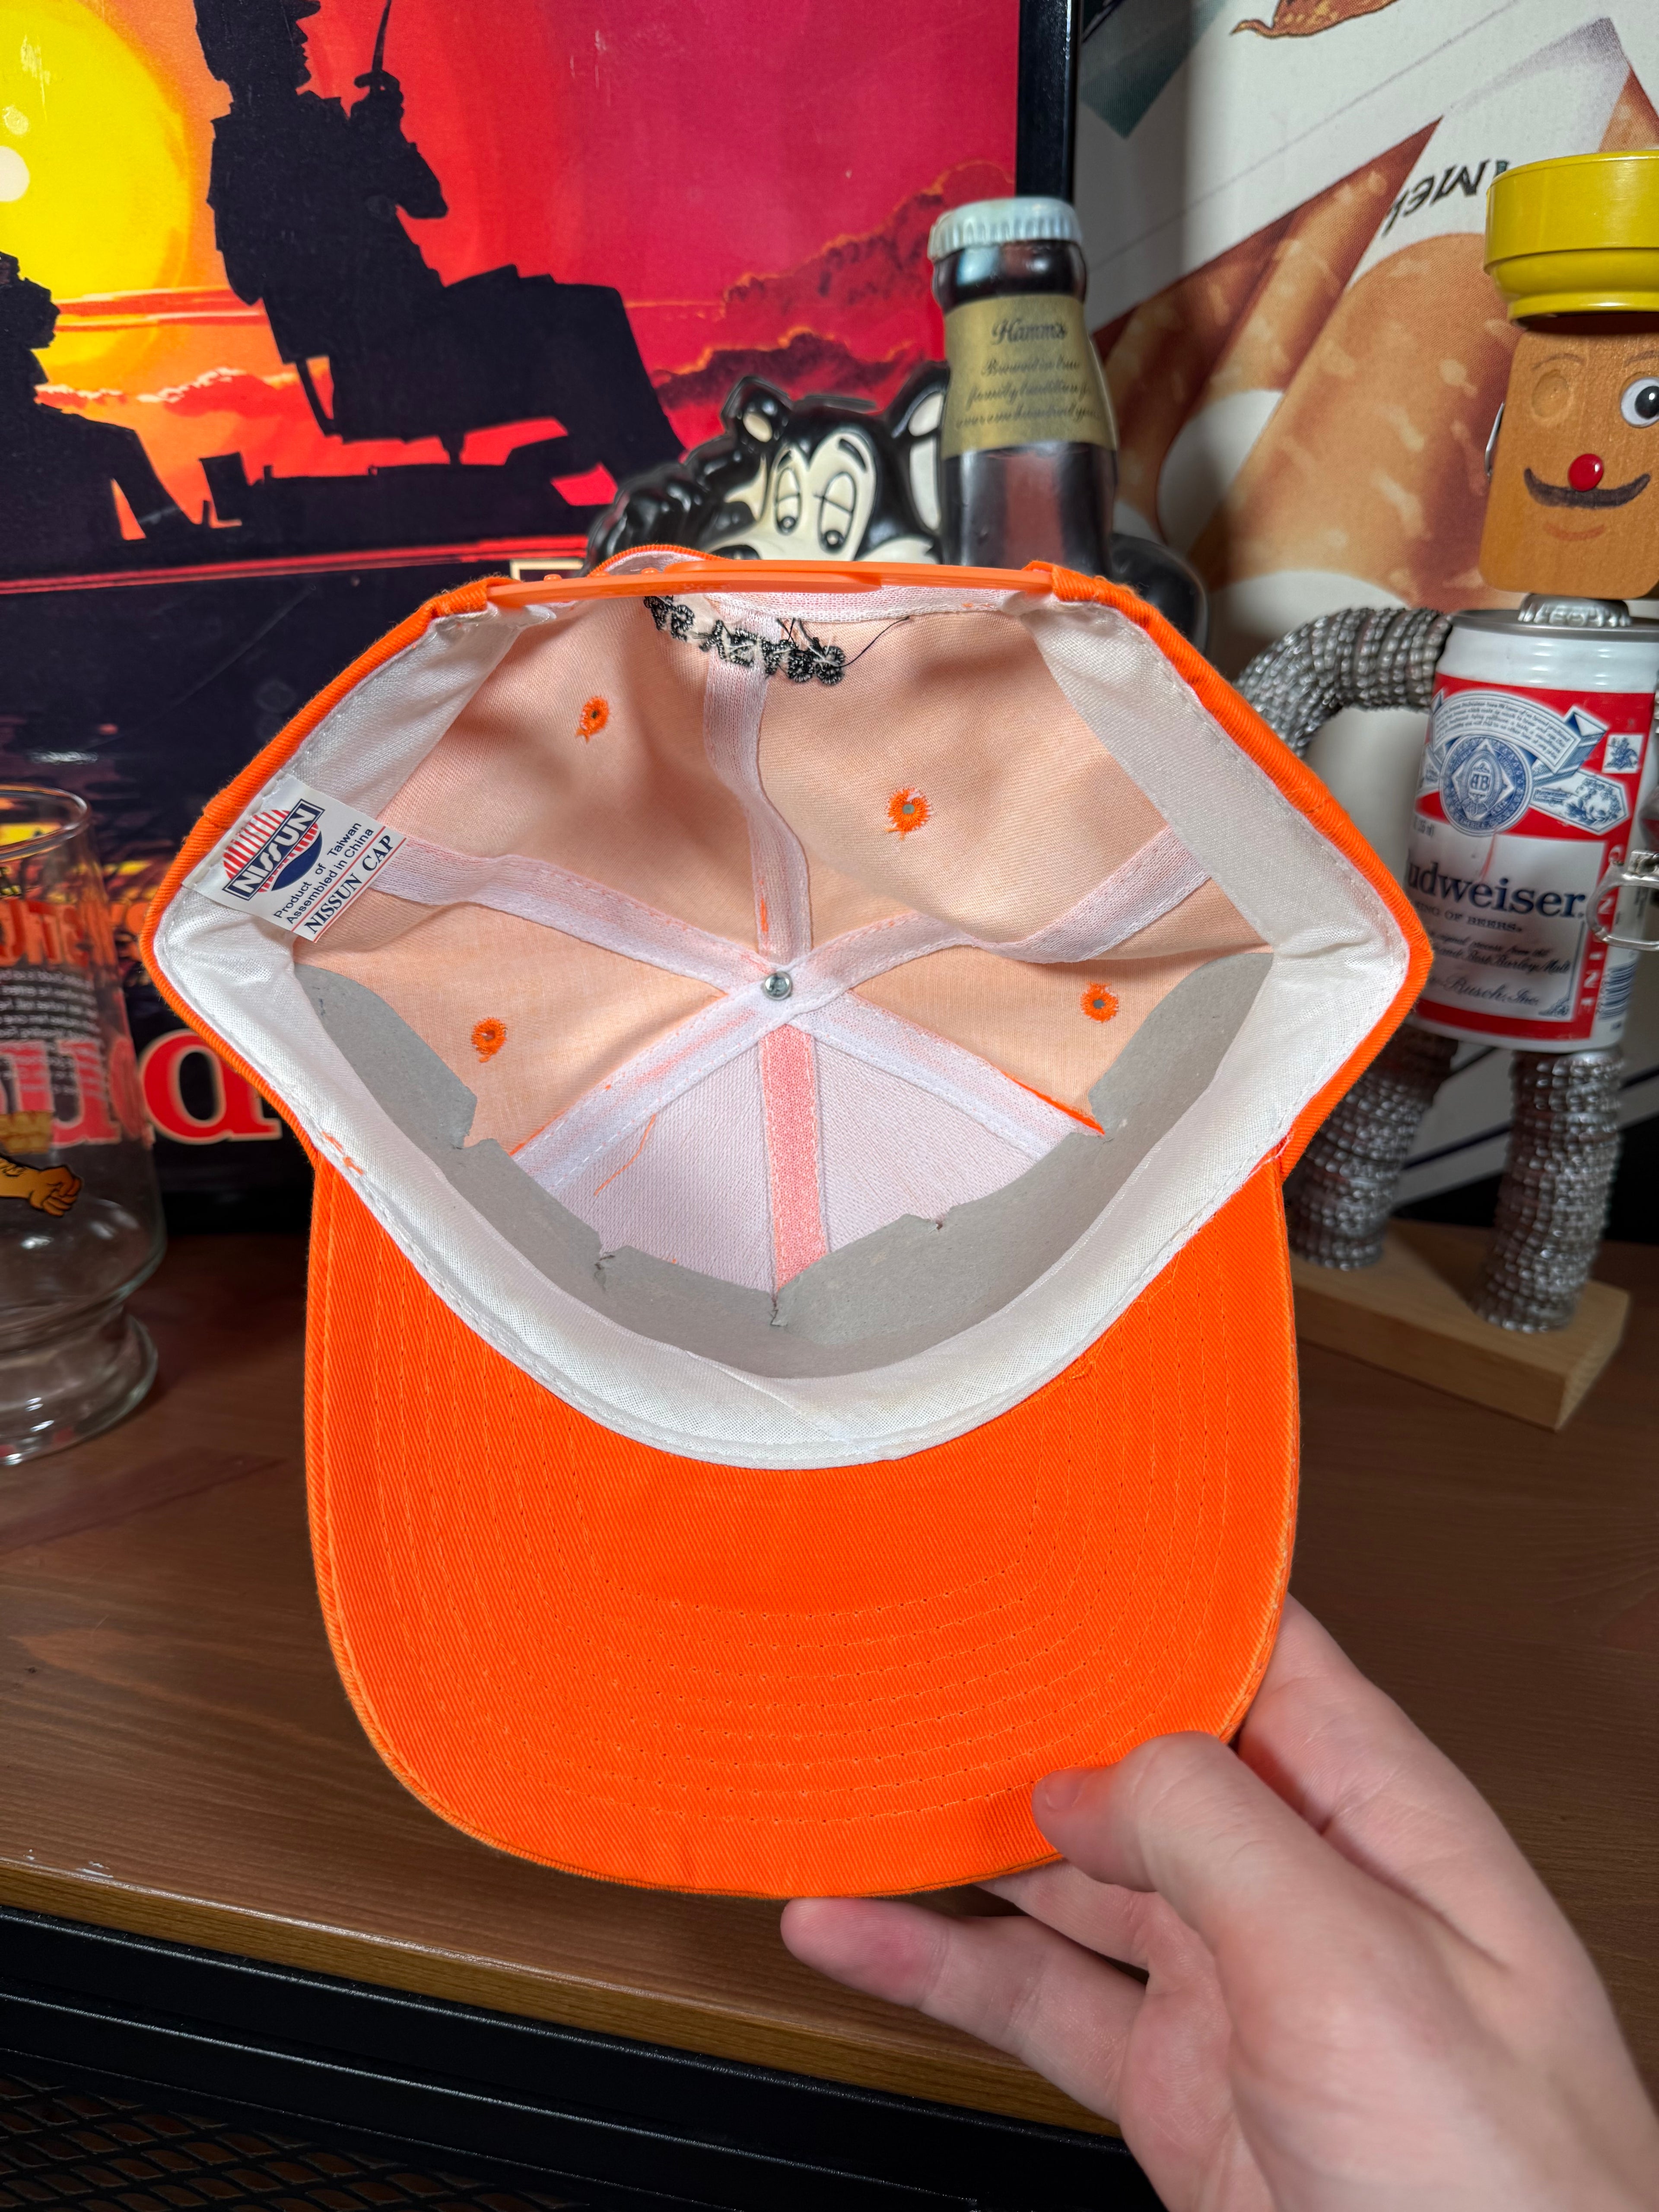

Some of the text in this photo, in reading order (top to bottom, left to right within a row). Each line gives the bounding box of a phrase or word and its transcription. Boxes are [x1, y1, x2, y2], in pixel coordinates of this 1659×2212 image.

[232, 807, 316, 894] NISSUN
[273, 822, 362, 918] Product of Taiwan
[286, 828, 374, 924] Assembled in China
[304, 835, 394, 934] NISSUN CAP
